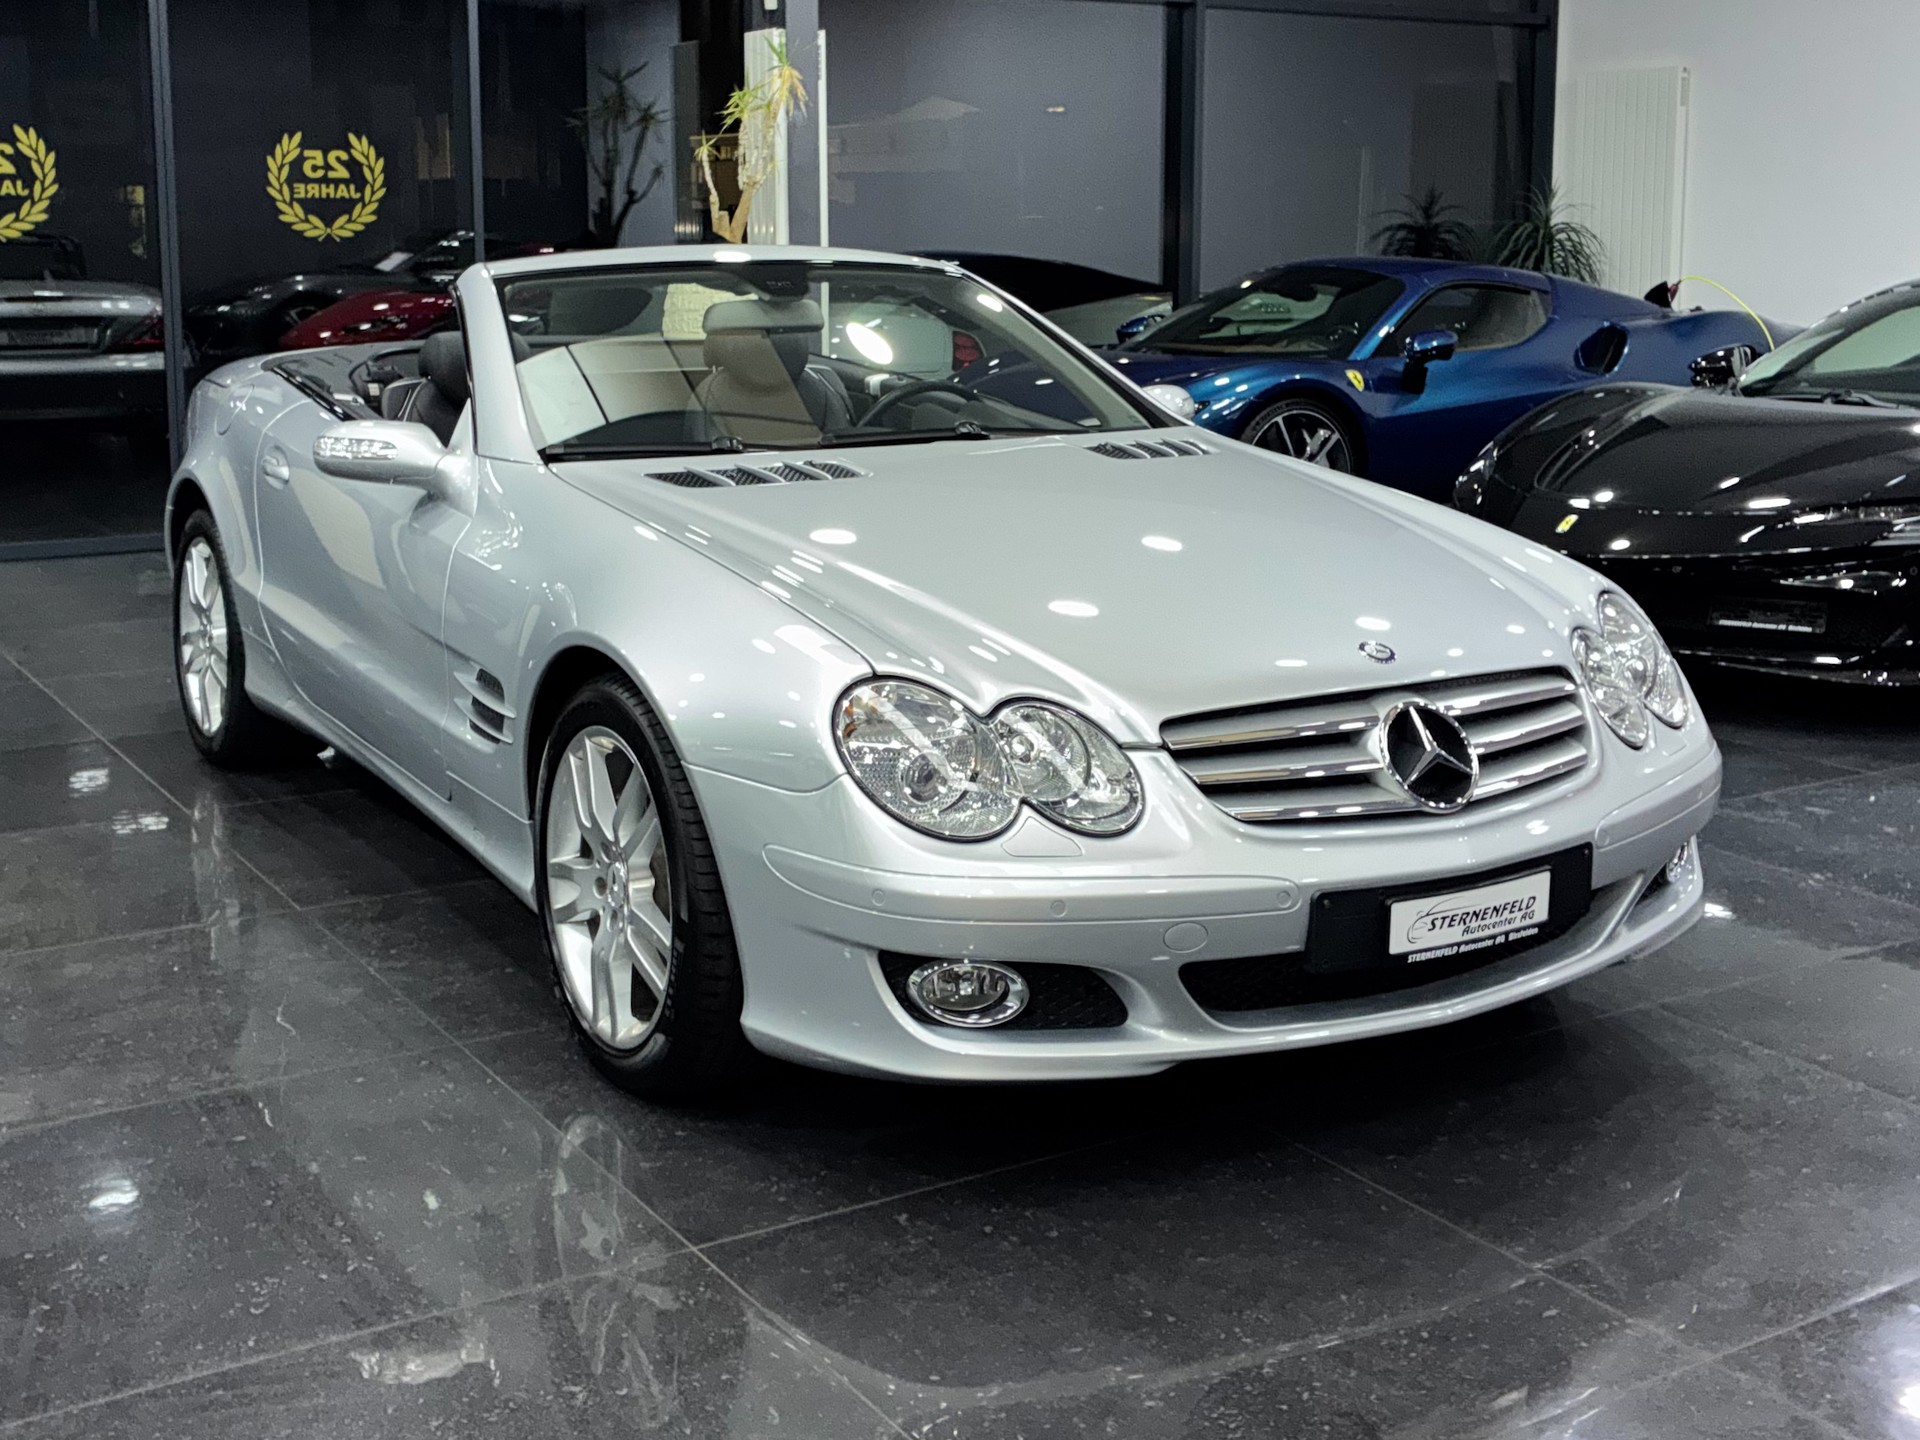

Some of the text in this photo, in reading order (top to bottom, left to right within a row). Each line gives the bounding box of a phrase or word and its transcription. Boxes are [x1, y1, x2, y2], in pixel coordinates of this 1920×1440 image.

[1427, 895, 1537, 932] STERNENFELD
[1461, 910, 1536, 937] Autocenter AG
[1407, 945, 1458, 963] STERNENFELD
[1458, 938, 1495, 954] Autocenter
[1495, 934, 1506, 946] AG
